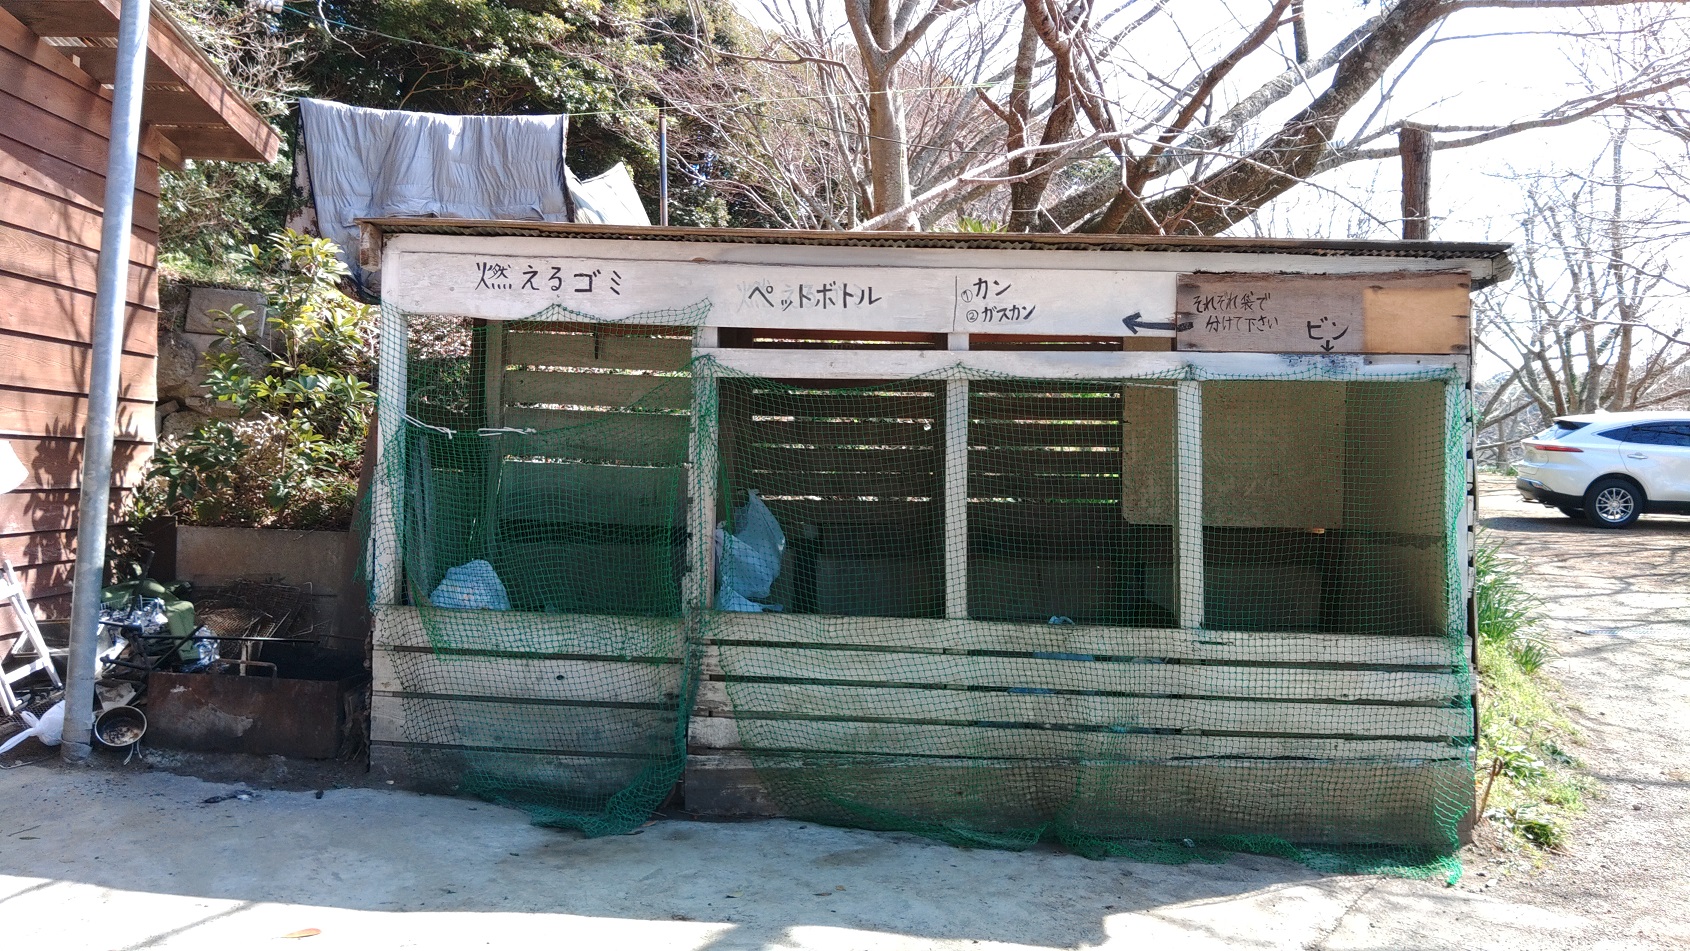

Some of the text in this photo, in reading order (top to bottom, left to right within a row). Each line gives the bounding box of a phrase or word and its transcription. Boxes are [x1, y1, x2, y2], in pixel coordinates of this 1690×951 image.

[475, 262, 622, 295] 燃えるゴミ
[748, 281, 882, 312] ペットボトル
[1193, 291, 1271, 313] それぞれ袋で
[1205, 315, 1279, 333] 分けて下さい
[1307, 316, 1349, 340] ビン
